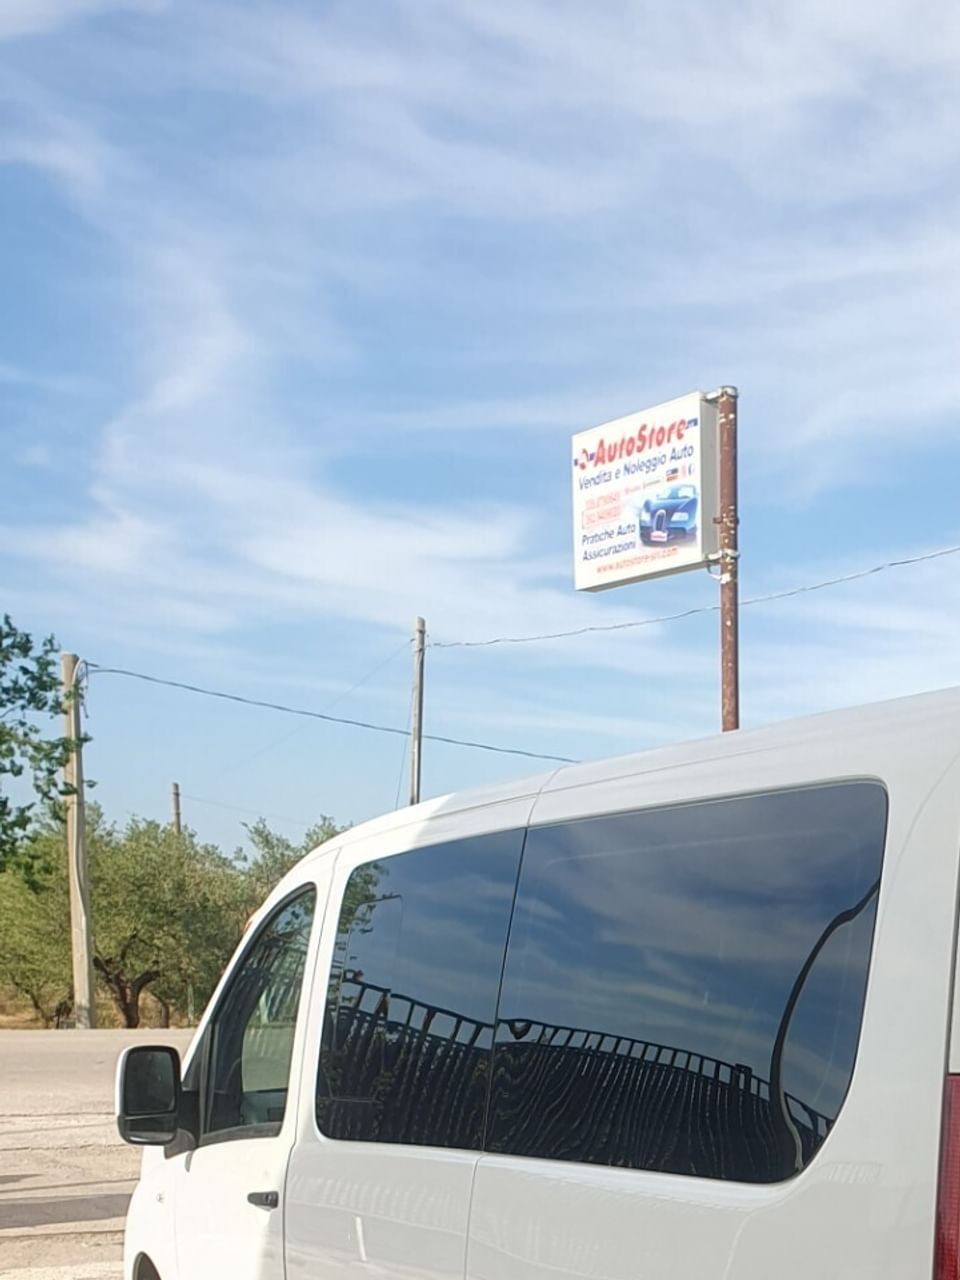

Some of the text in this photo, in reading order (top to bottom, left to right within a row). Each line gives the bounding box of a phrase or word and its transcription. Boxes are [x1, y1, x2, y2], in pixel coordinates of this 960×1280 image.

[594, 418, 686, 467] AutoStore
[578, 470, 612, 490] Vendita
[614, 468, 621, 479] e
[623, 452, 667, 478] Noleggio
[669, 444, 695, 462] Auto
[581, 529, 615, 546] Pratiche
[616, 523, 636, 537] Auto
[582, 541, 637, 562] Assicurazioni
